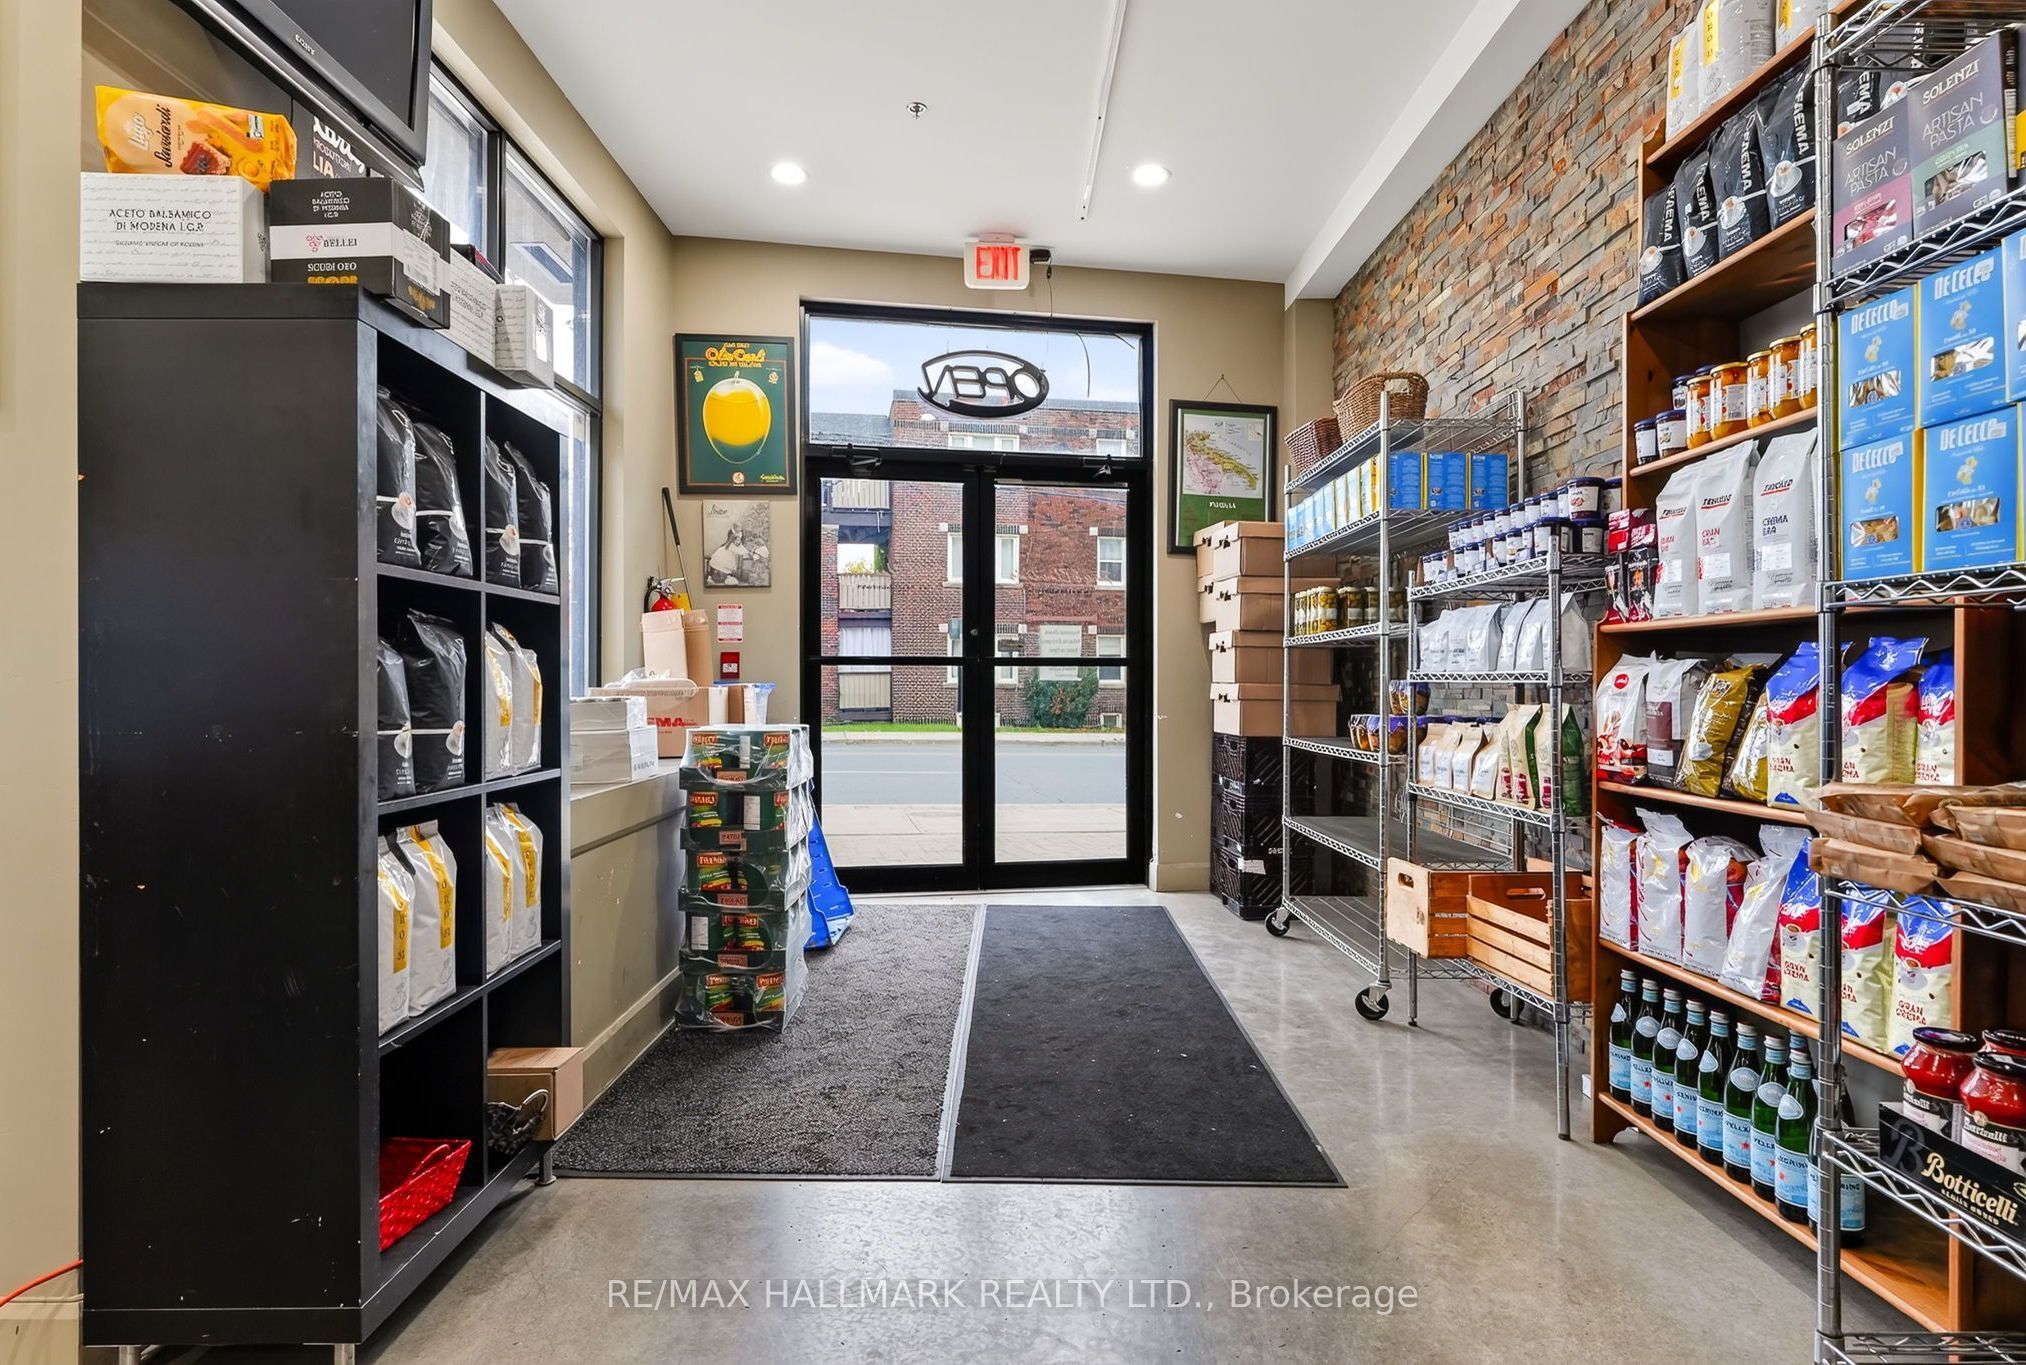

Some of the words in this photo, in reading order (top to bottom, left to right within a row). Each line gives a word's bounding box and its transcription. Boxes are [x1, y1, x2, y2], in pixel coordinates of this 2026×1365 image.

[1922, 58, 1980, 105] SOLENZI
[1793, 89, 1810, 155] FAEMA
[1922, 91, 1983, 140] ARTISAN
[1845, 115, 1895, 155] SOLENZI
[1930, 114, 1975, 150] PASTA
[1740, 131, 1752, 192] FAEMA
[1845, 146, 1896, 187] ARTISAN
[1850, 166, 1889, 197] PASTA
[109, 209, 145, 219] ACETO
[149, 209, 212, 220] BALSAMICO
[116, 221, 126, 231] DI
[130, 221, 176, 231] MODENA
[324, 238, 357, 248] BELLEI
[976, 246, 1023, 280] EXIT
[1934, 275, 1950, 300] DE
[1851, 309, 1865, 335] DE
[1940, 428, 1956, 451] DE
[1852, 451, 1866, 474] DE
[1898, 1000, 1924, 1014] GRAN
[1921, 1152, 2018, 1225] Botticelli
